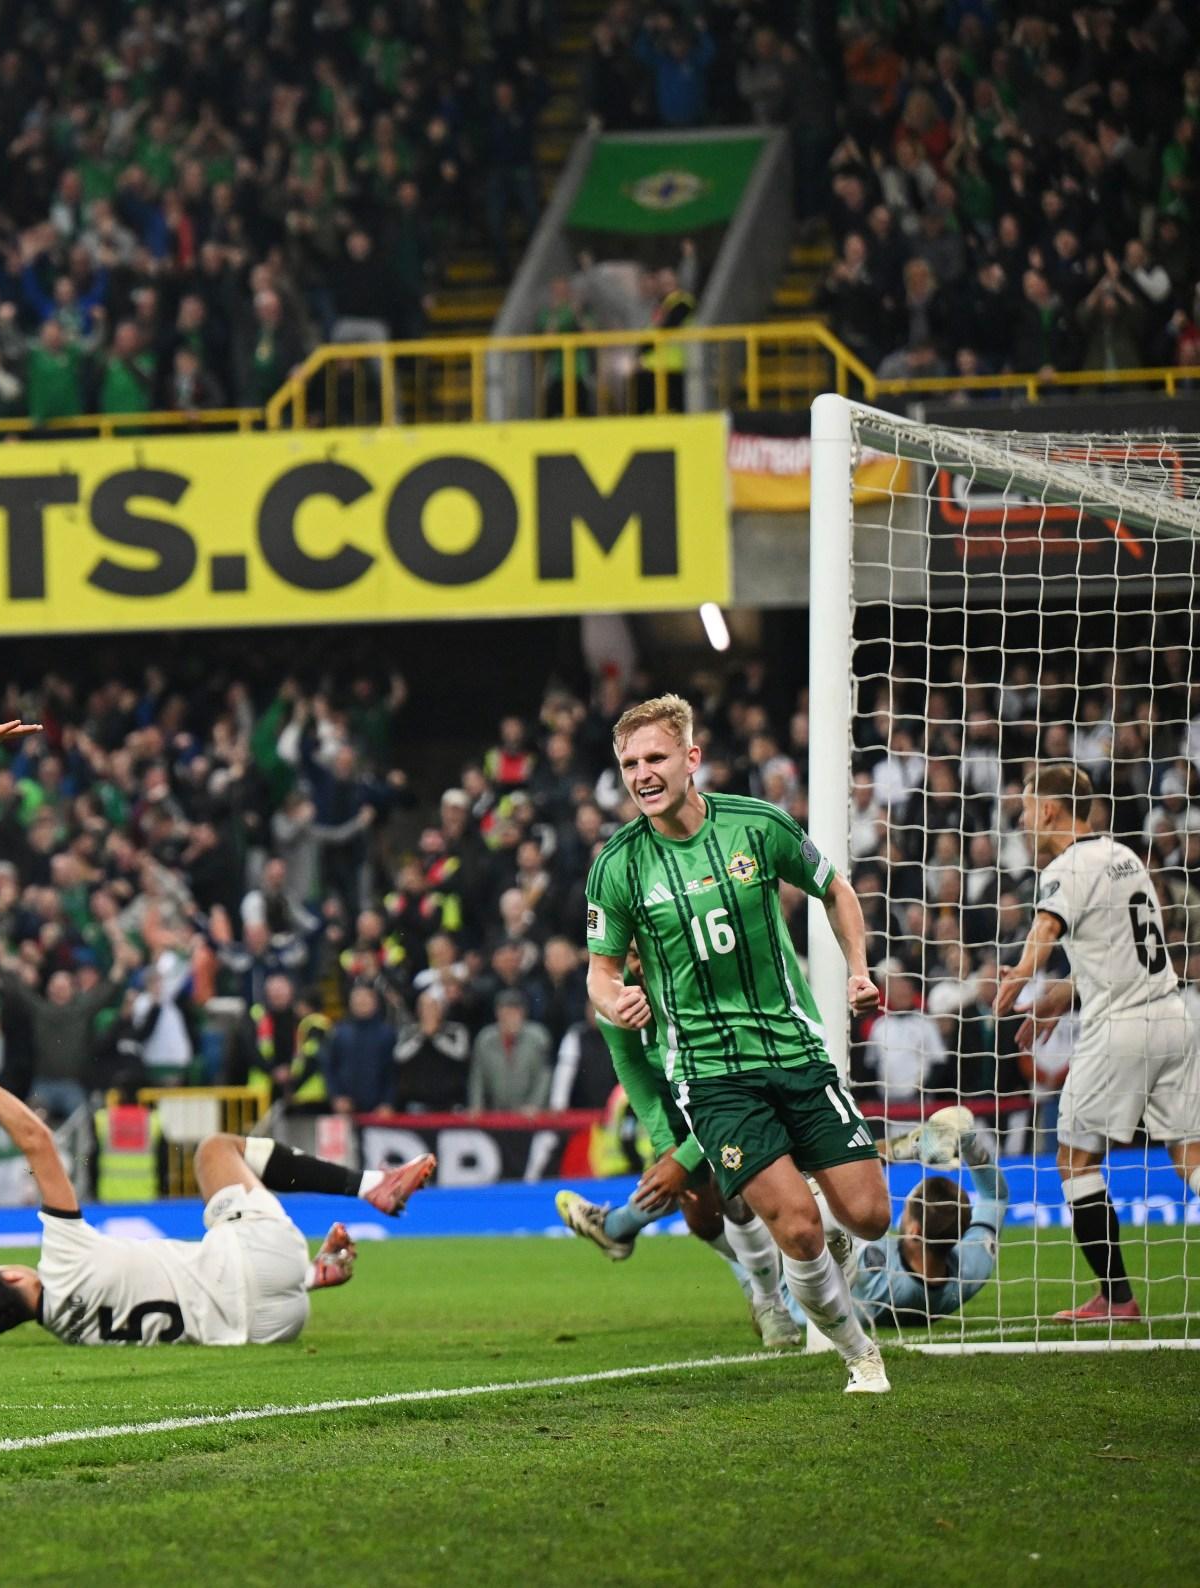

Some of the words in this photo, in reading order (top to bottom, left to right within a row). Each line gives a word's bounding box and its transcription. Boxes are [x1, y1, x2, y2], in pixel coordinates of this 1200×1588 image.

[690, 907, 736, 961] 16
[1128, 890, 1167, 975] 6
[99, 1300, 185, 1342] 5
